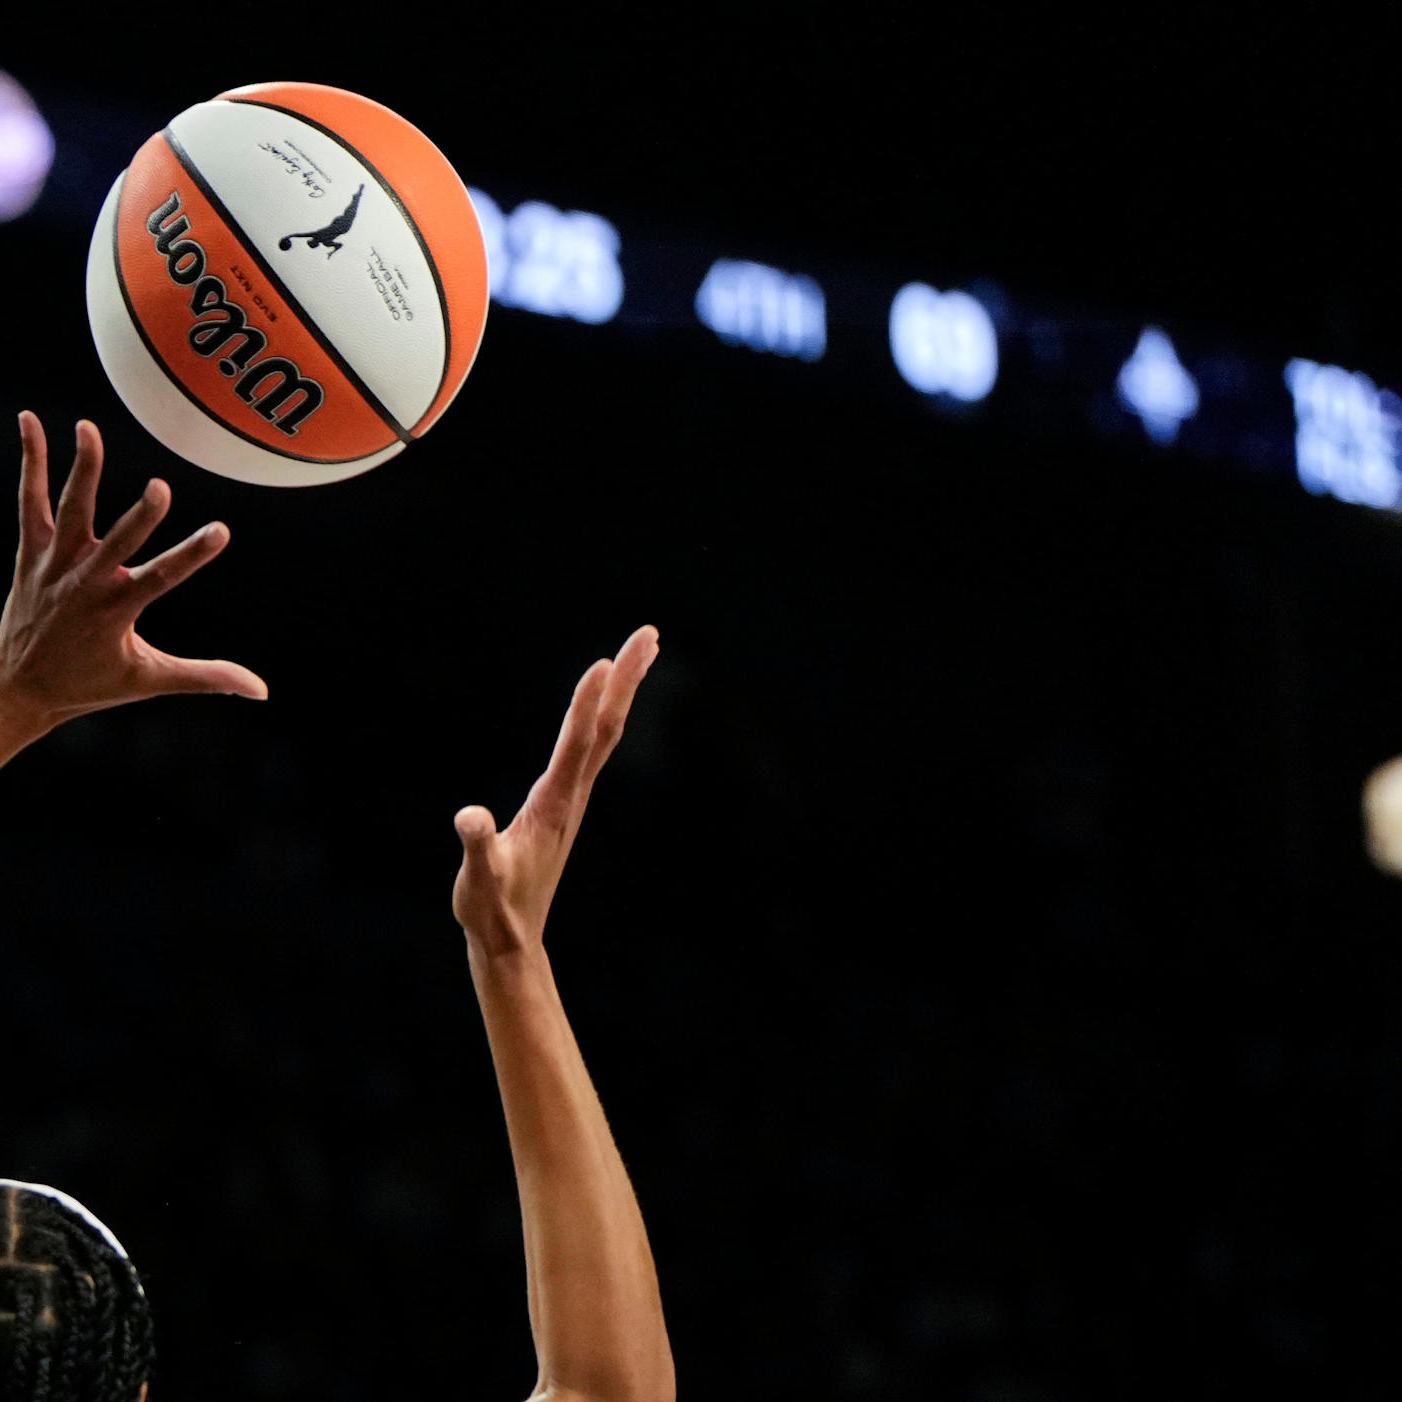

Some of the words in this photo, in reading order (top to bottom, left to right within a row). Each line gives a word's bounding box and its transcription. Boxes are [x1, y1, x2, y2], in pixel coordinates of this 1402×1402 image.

[230, 265, 252, 292] NXT
[370, 246, 393, 282] BALL
[253, 294, 278, 322] EVO
[365, 262, 401, 321] OFFICIAL
[390, 282, 414, 322] GAME
[146, 190, 326, 438] Wilson
